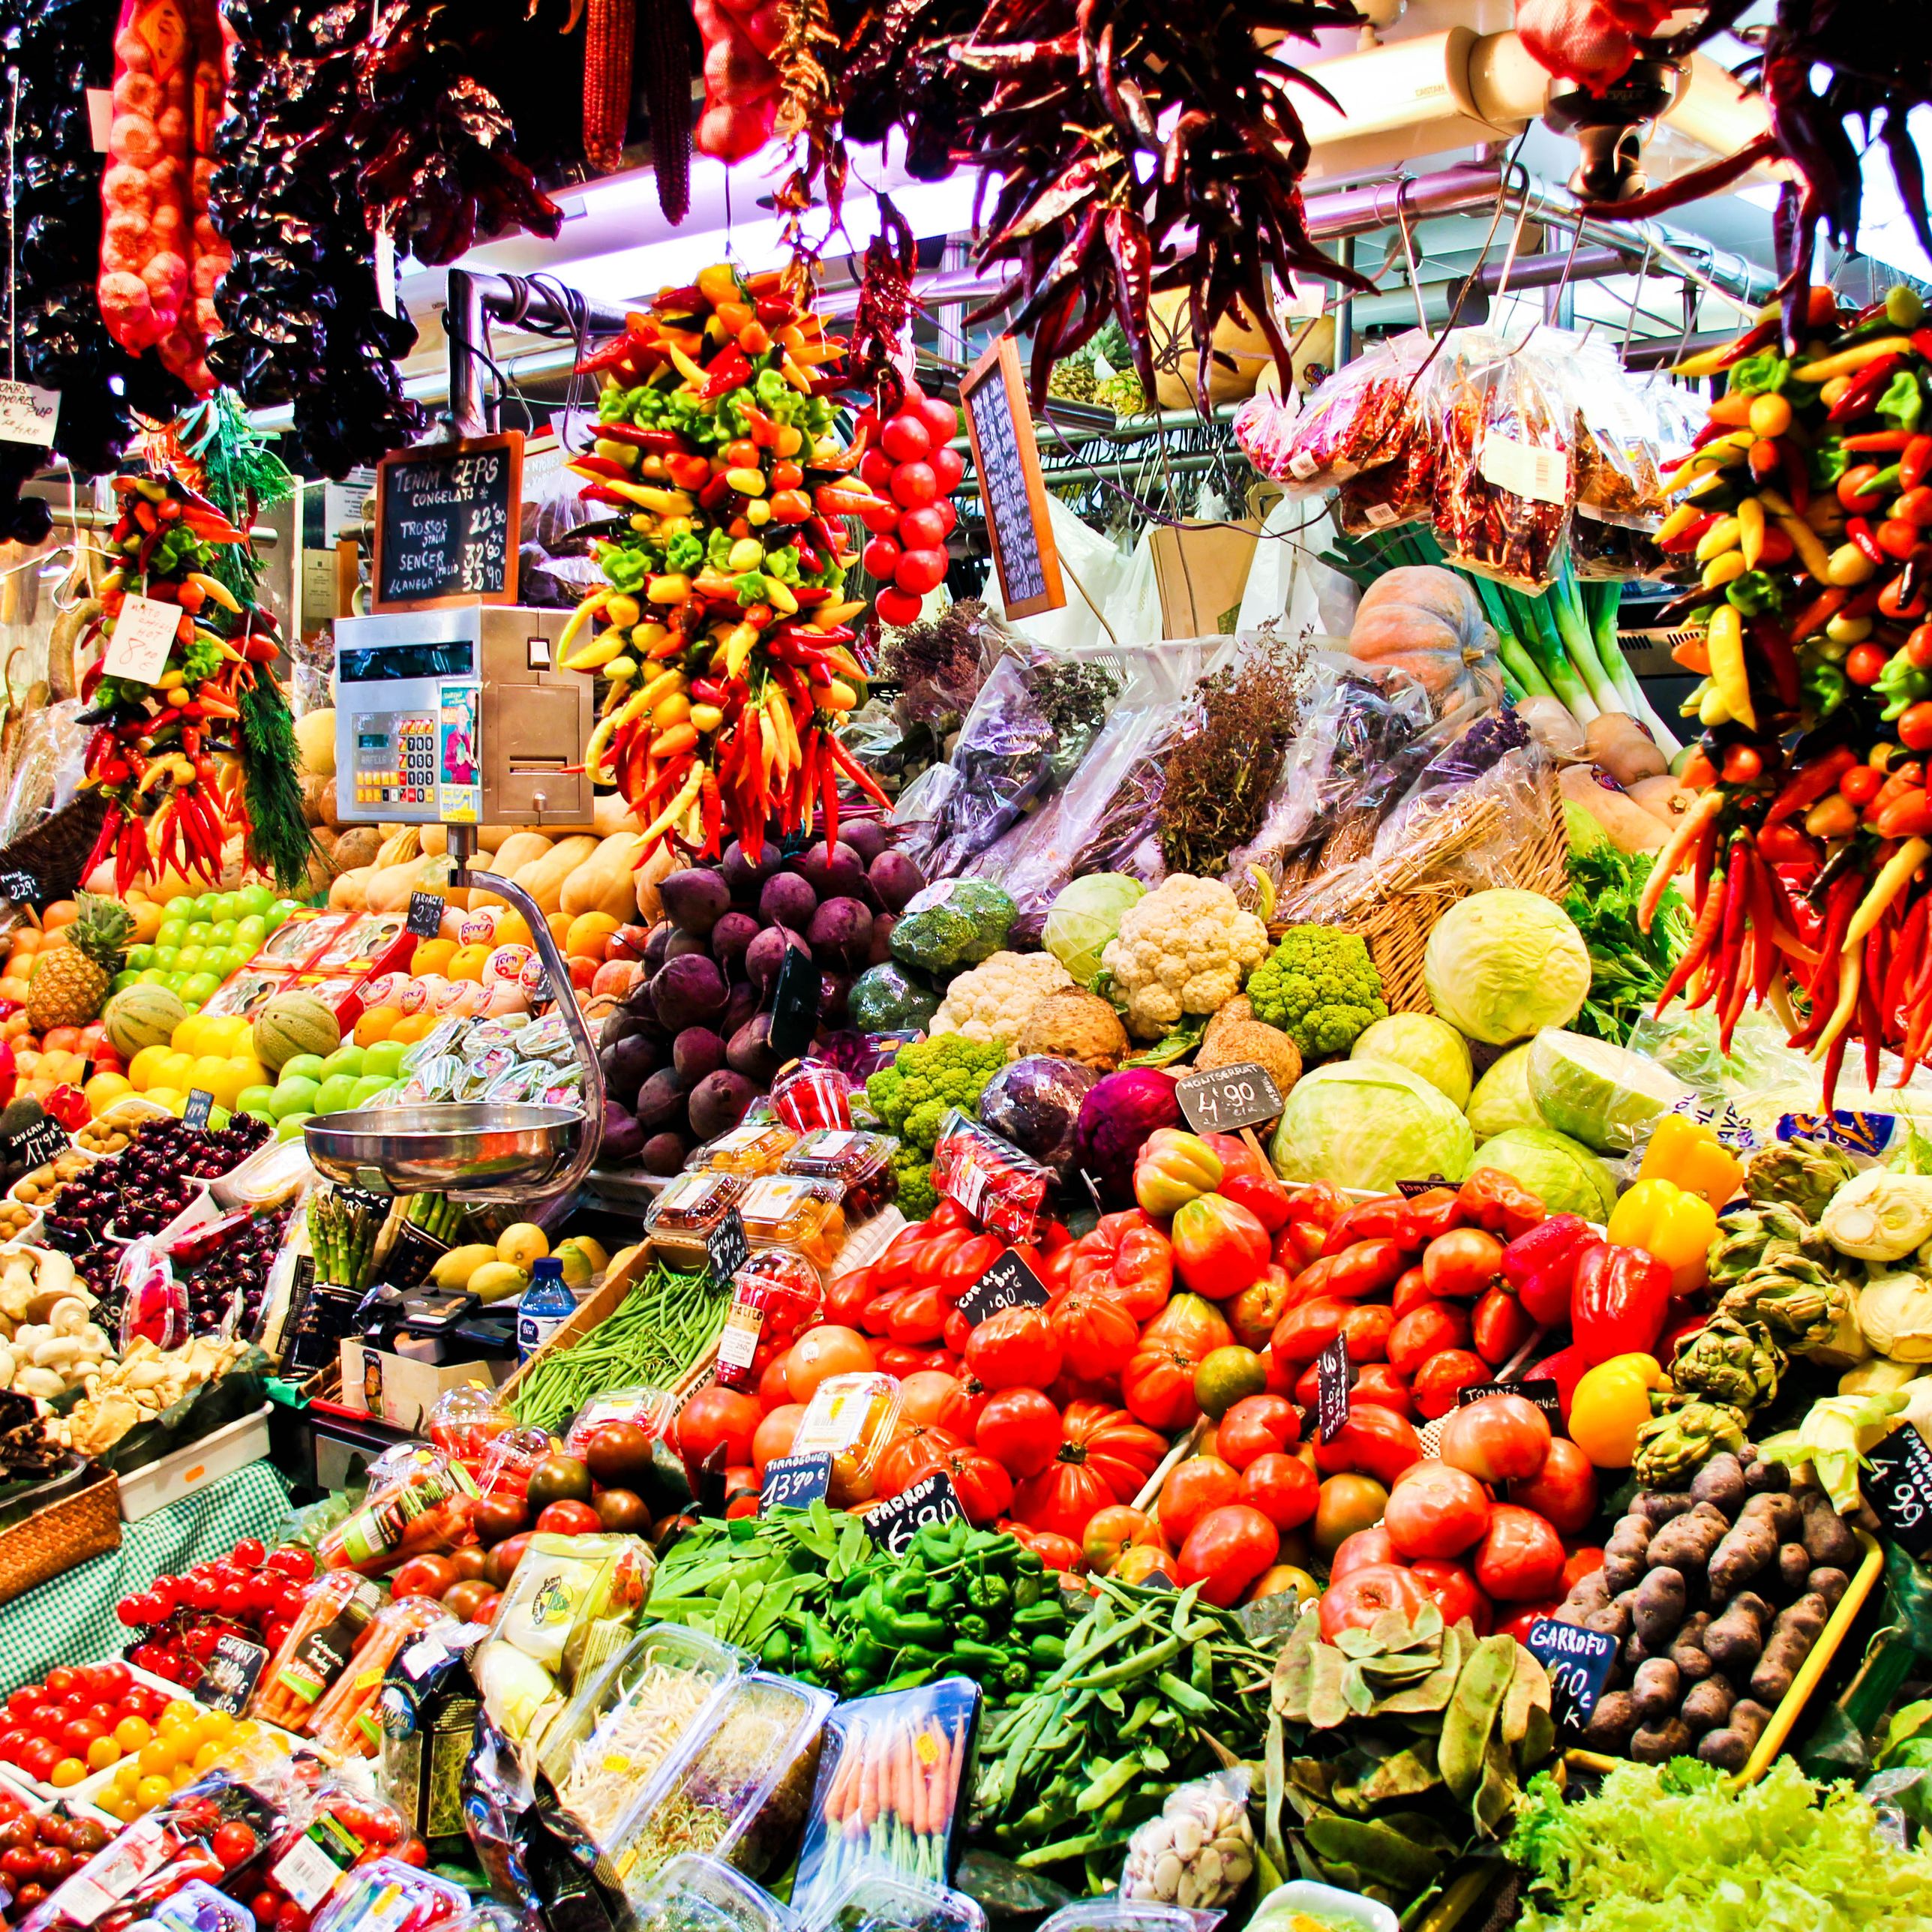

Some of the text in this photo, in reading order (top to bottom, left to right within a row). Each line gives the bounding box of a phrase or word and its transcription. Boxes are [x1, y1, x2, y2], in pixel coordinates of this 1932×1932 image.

[451, 457, 499, 487] CEPS
[412, 488, 474, 508] CONGELATS
[399, 550, 445, 571] SENCER
[1180, 1064, 1258, 1090] MONTSERRAT
[1198, 1082, 1255, 1122] 4'90
[759, 1471, 814, 1507] 13'90
[818, 1467, 825, 1480] €
[866, 1476, 935, 1527] PADRON
[218, 1637, 260, 1665] CHERRY
